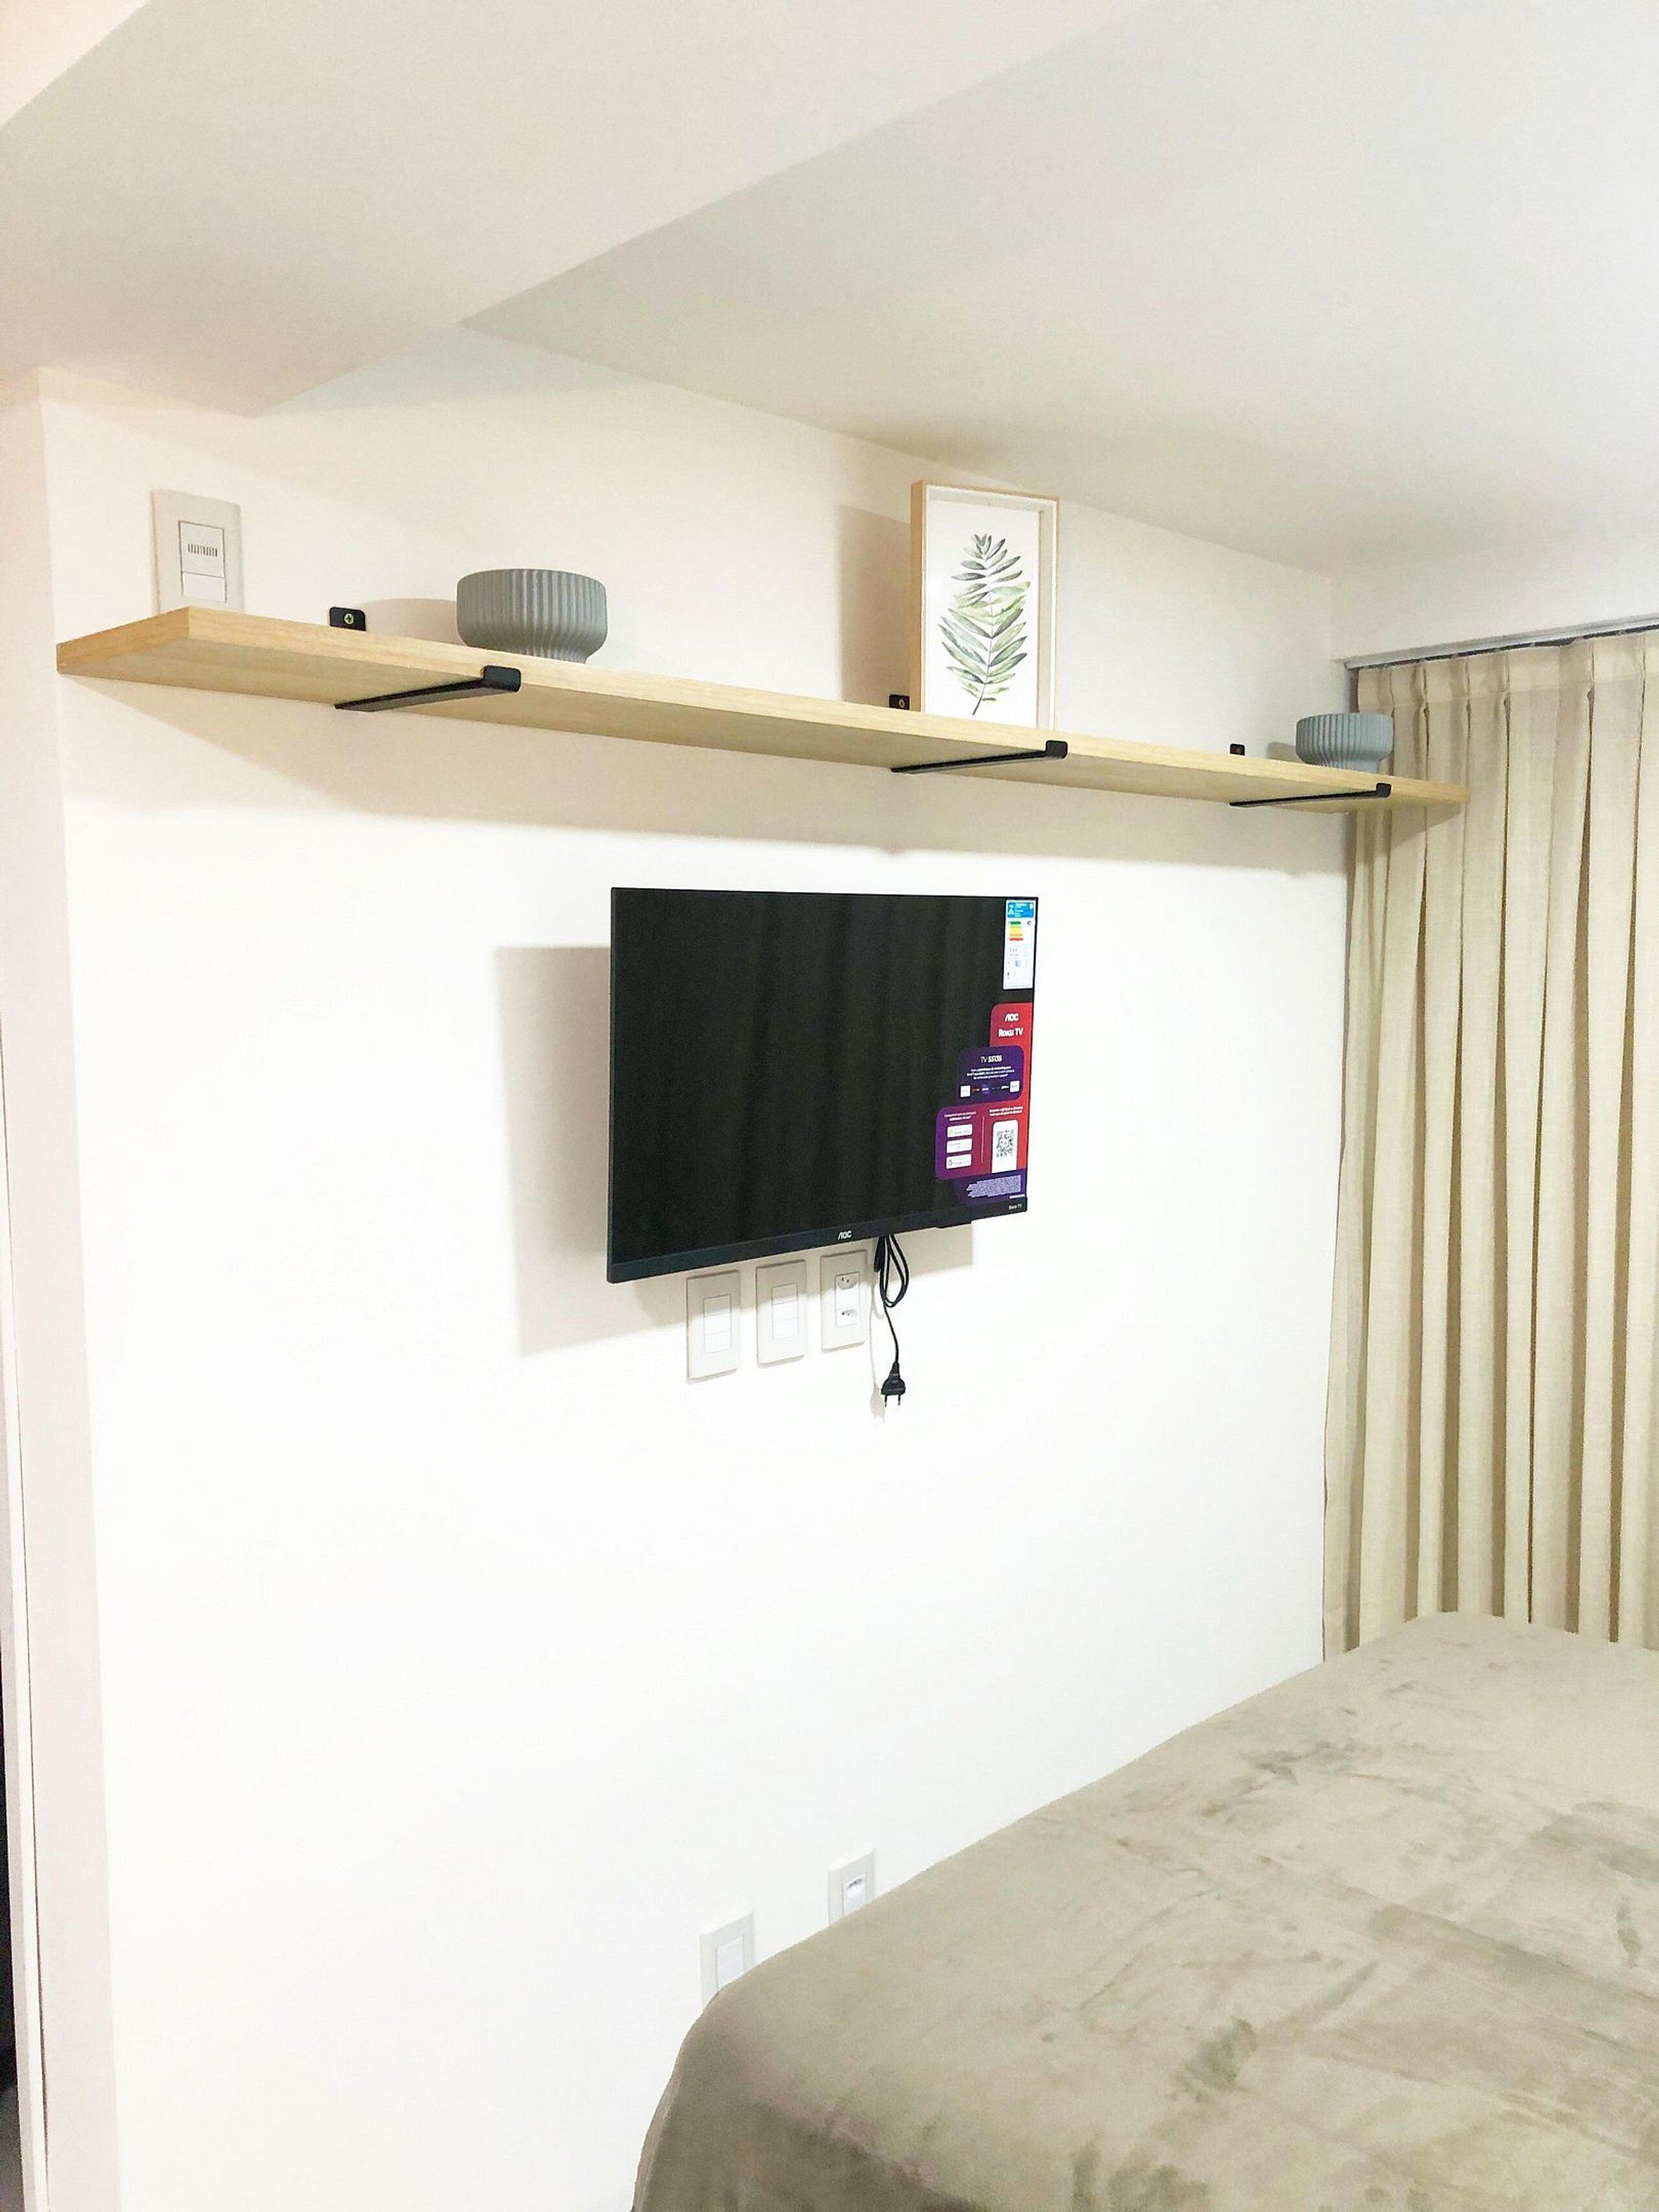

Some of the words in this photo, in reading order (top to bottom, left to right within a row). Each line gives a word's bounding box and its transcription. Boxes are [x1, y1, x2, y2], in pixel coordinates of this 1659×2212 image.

[1004, 1013, 1019, 1021] AOC
[1015, 1027, 1024, 1036] TV
[837, 1230, 852, 1240] AOC
